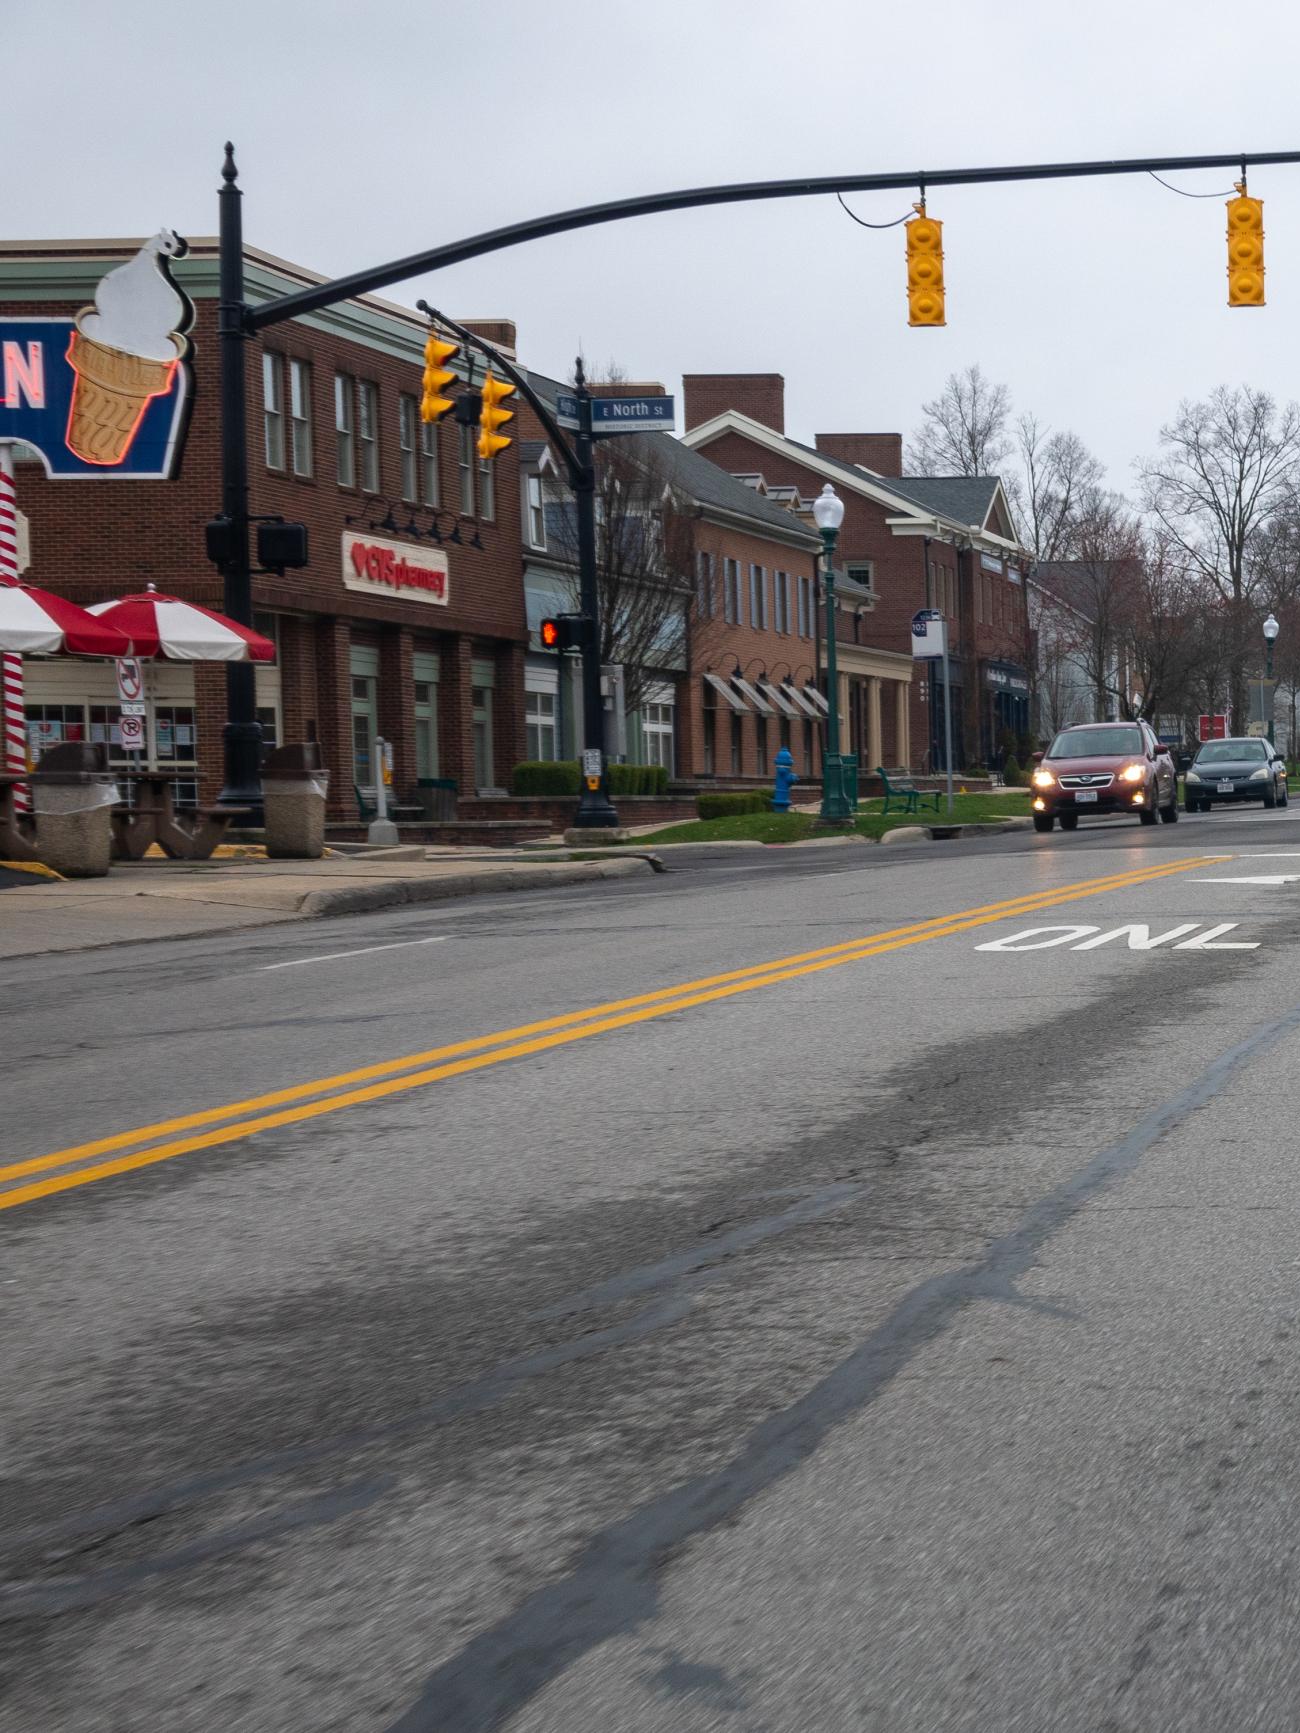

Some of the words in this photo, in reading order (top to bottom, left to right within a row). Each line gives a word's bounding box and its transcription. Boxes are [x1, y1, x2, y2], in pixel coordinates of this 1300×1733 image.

[2, 341, 45, 409] N
[603, 407, 609, 417] E
[613, 402, 649, 417] North
[653, 406, 663, 416] St
[912, 623, 926, 631] 102
